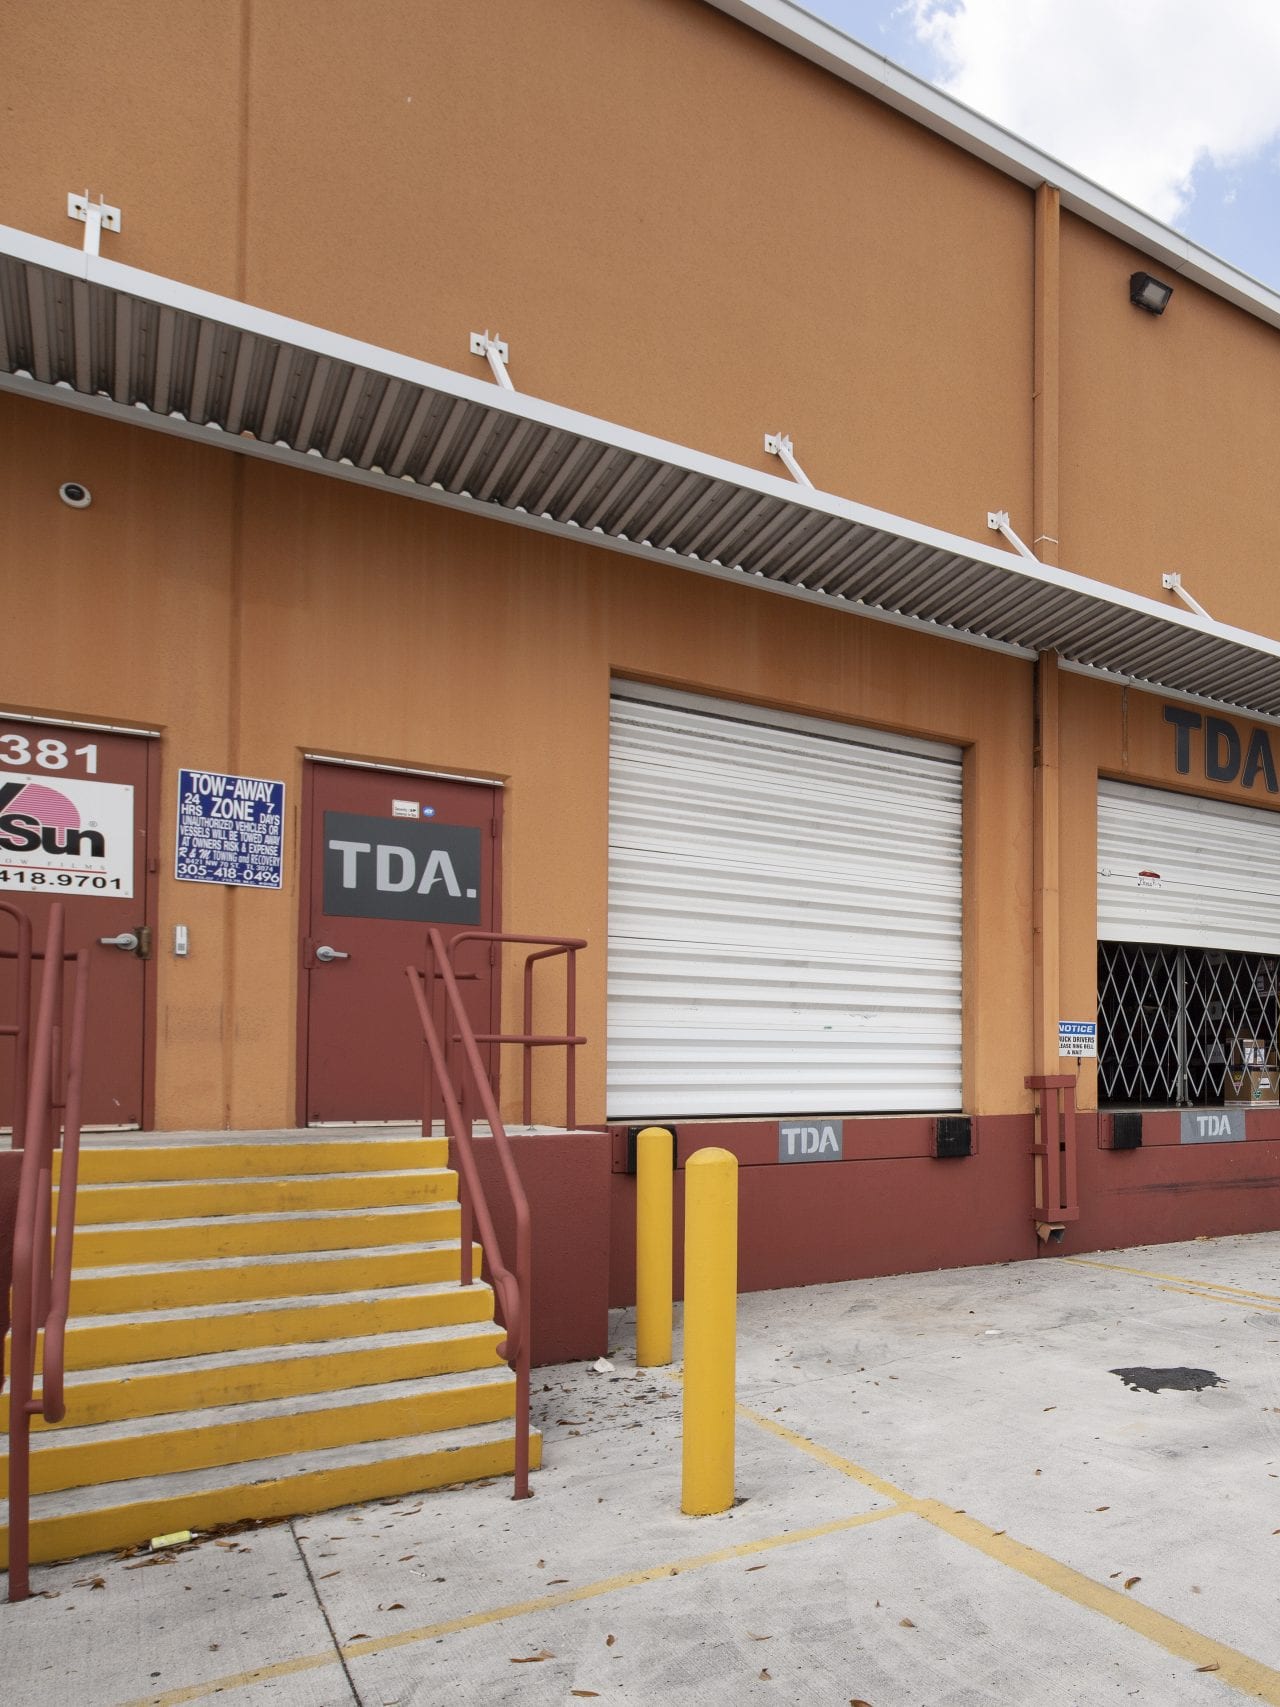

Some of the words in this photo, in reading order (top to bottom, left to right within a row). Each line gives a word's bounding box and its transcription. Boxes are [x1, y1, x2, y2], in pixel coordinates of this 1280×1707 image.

[0, 734, 98, 774] 381
[190, 773, 274, 803] TOW-AWAY
[184, 792, 200, 805] 24
[266, 803, 275, 814] 7
[181, 803, 203, 817] HRS
[211, 797, 254, 821] ZONE
[182, 815, 234, 830] UNAUTHORIZED
[235, 820, 267, 834] VEHICLES
[268, 825, 279, 835] OR
[260, 813, 280, 826] DAYS
[180, 825, 210, 838] VESSELS
[212, 828, 228, 840] WILL
[229, 830, 239, 841] BE
[240, 832, 262, 843] TOWED
[182, 836, 190, 846] AT
[192, 837, 222, 850] OWNERS
[223, 841, 239, 852] RISK
[241, 843, 247, 853] &
[249, 843, 278, 856] EXPENSE
[48, 861, 106, 870] FILMS
[213, 850, 238, 862] TOWING
[238, 854, 250, 863] and
[250, 854, 280, 867] RECOVERY
[178, 863, 280, 883] 305-418-0496
[329, 840, 477, 898] TDA.
[1073, 1036, 1095, 1044] DRIVERS
[1196, 1114, 1231, 1137] TDA
[781, 1126, 839, 1155] TDA
